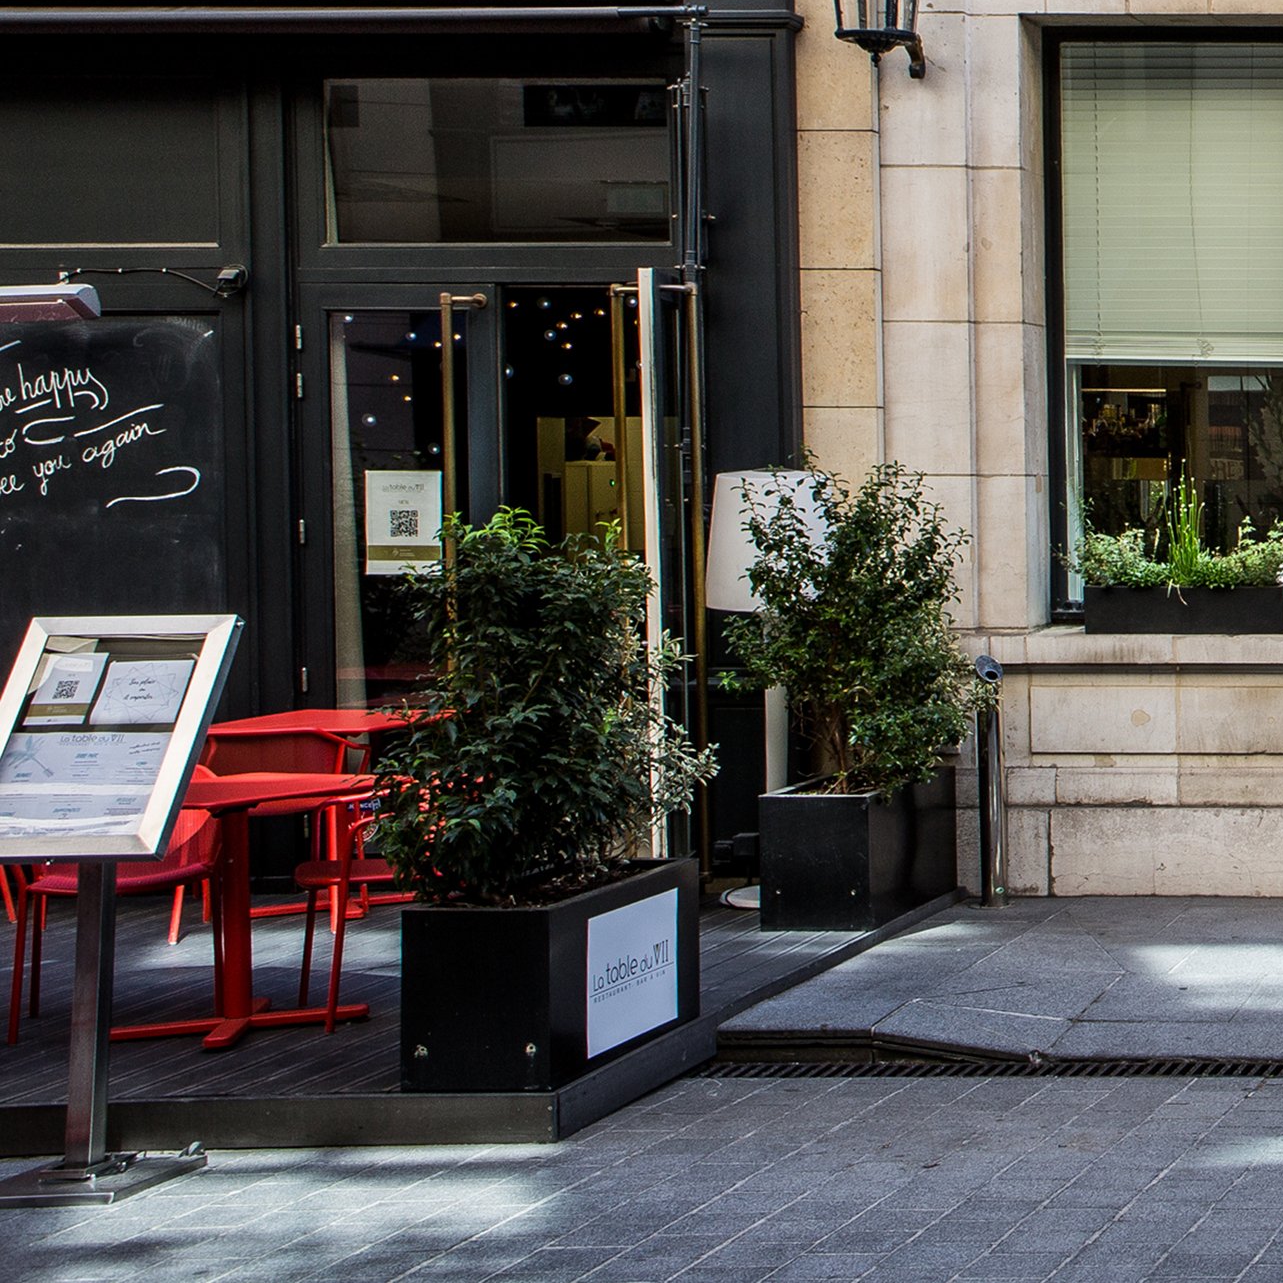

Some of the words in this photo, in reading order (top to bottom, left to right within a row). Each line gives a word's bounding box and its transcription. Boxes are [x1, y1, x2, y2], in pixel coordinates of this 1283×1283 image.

[17, 362, 109, 411] happy
[32, 454, 72, 497] you
[82, 421, 168, 469] again
[592, 974, 604, 992] La
[606, 954, 638, 985] table
[640, 954, 653, 973] du
[653, 939, 669, 966] VII
